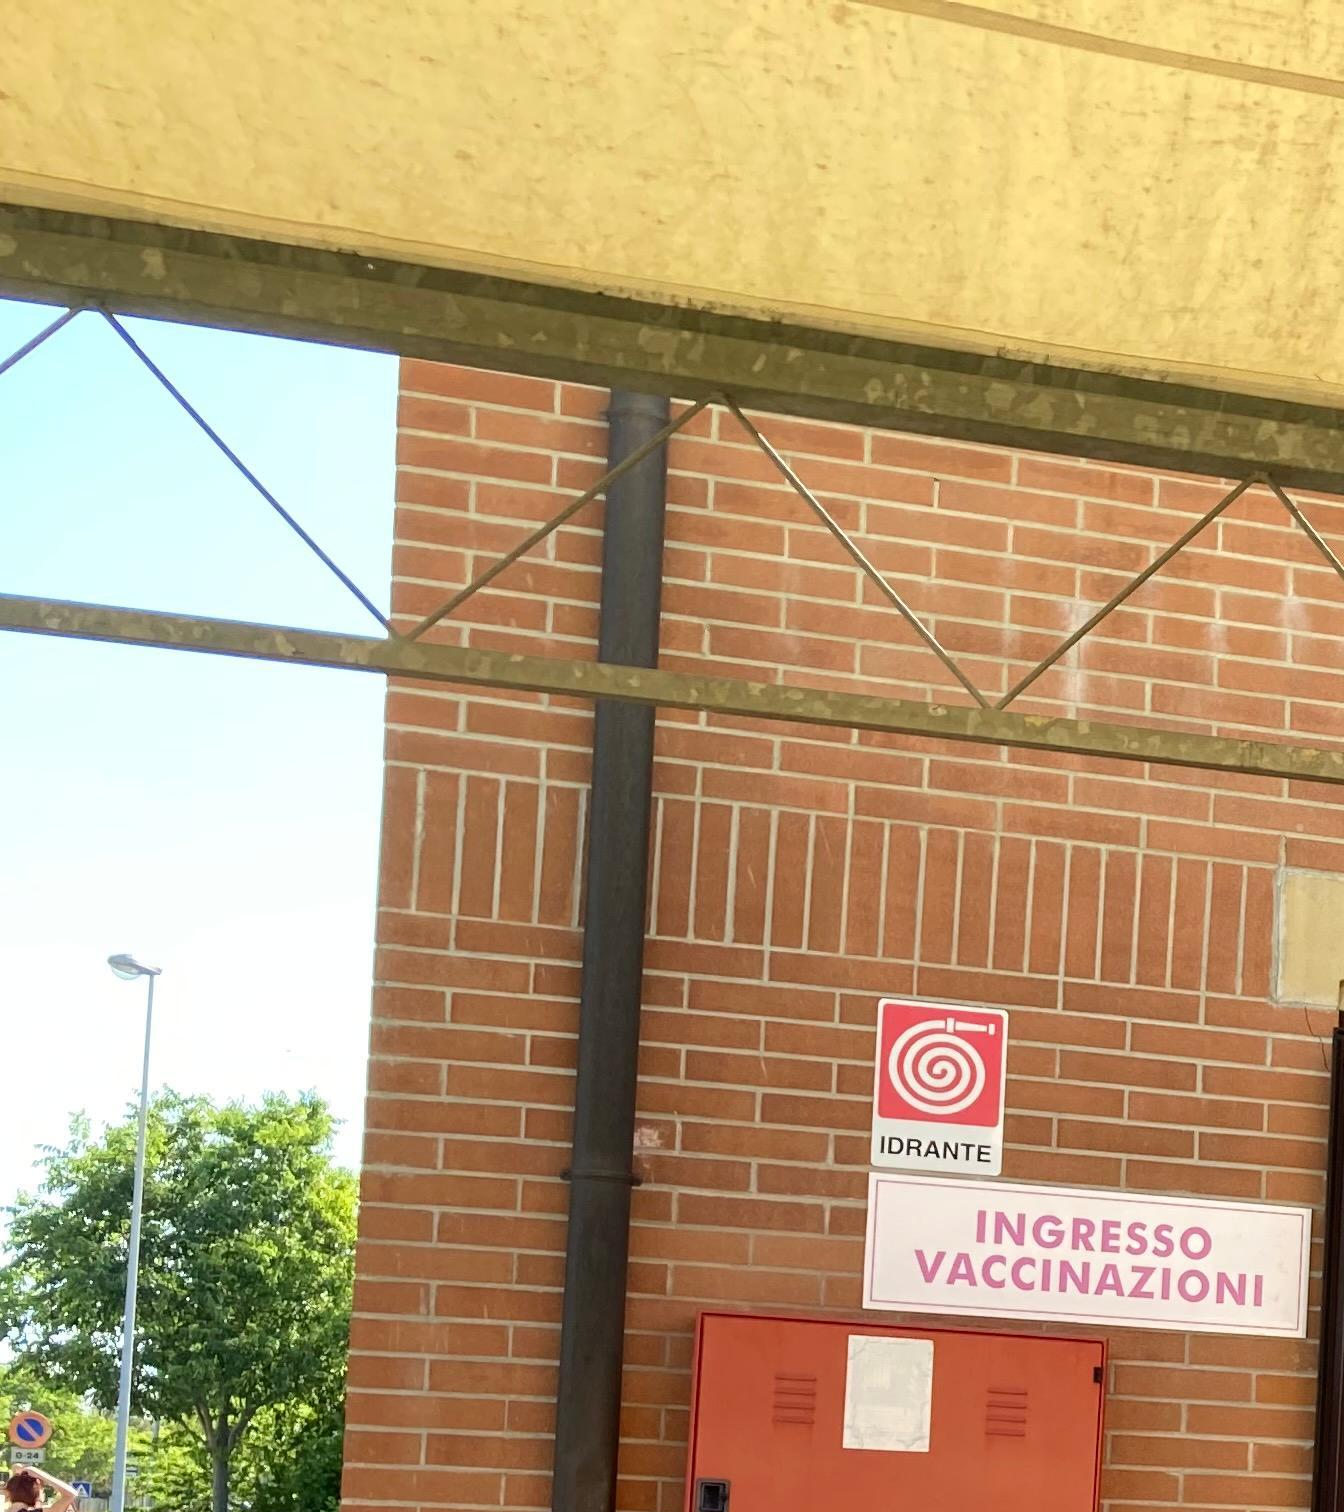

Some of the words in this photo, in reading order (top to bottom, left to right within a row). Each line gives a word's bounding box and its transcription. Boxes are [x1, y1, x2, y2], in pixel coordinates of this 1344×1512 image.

[880, 1136, 991, 1162] IDRANTE
[976, 1209, 1212, 1260] INGRESSO
[914, 1249, 1264, 1307] VACCINAZIONI
